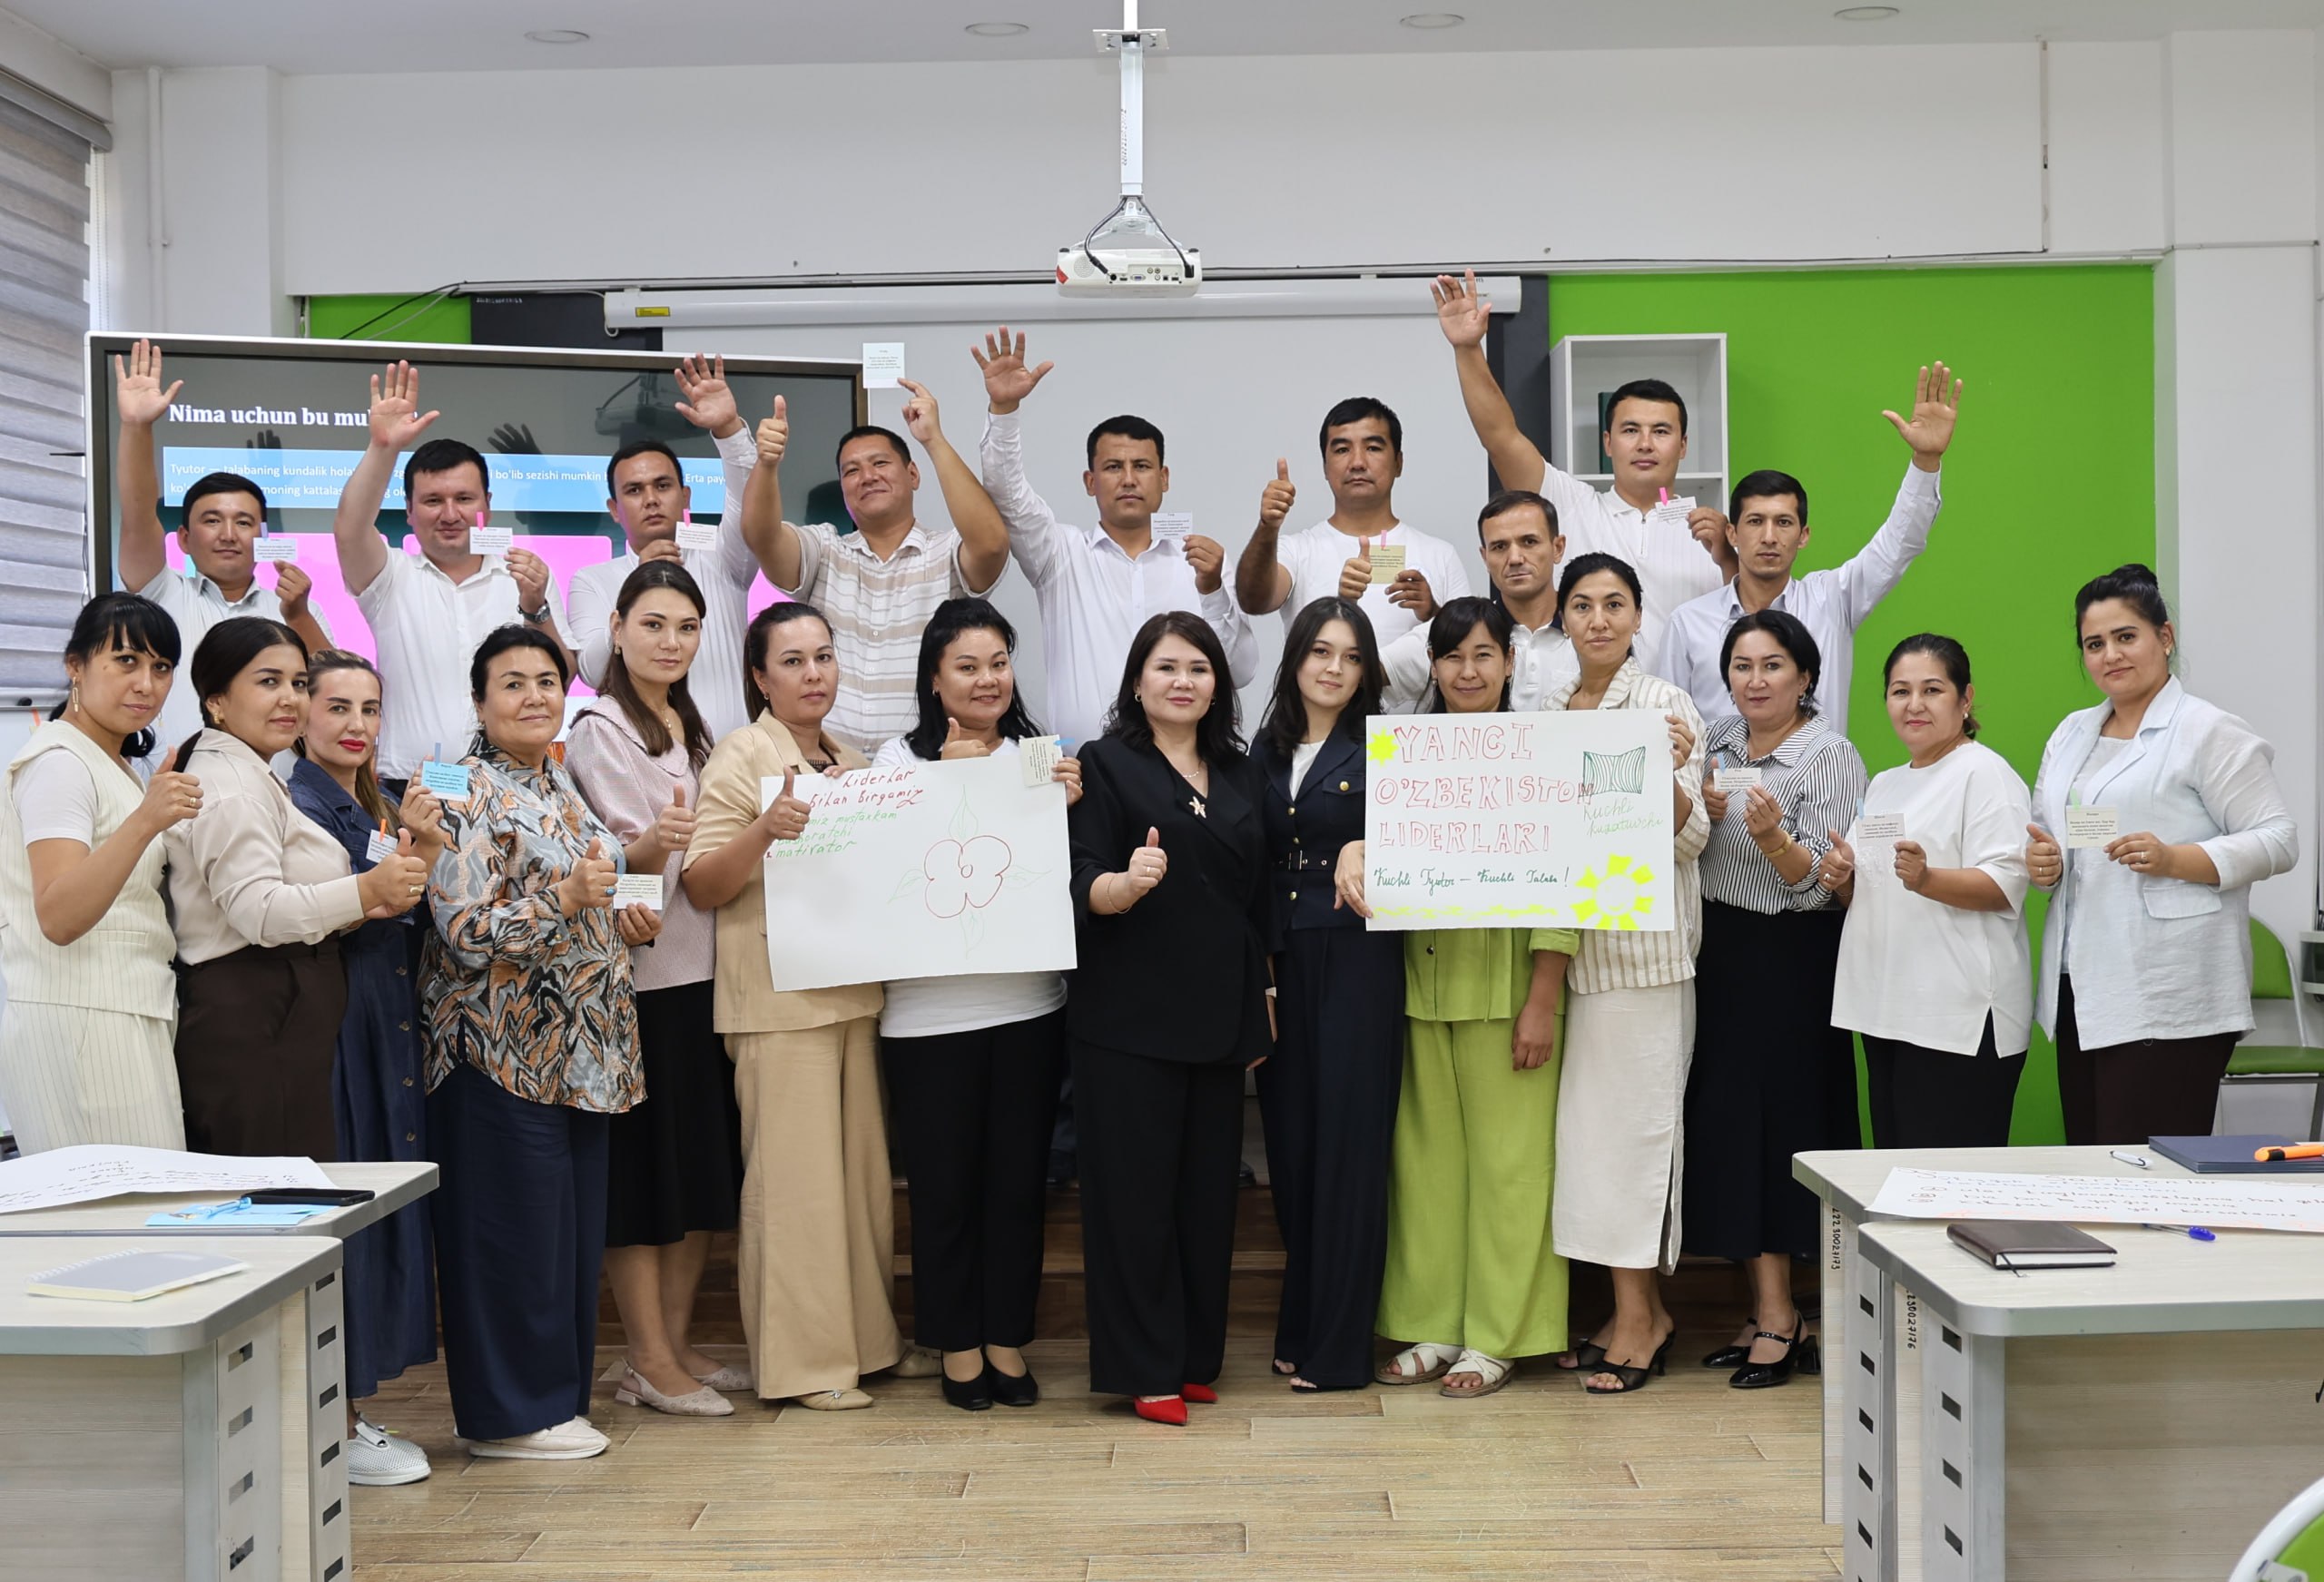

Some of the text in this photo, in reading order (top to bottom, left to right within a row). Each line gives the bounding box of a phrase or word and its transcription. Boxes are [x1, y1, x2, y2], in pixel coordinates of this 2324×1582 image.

[169, 404, 225, 424] Nima
[231, 406, 297, 425] uchun
[301, 408, 330, 425] bu
[170, 464, 205, 476] Tyutor
[223, 465, 281, 477] talabaning
[282, 466, 327, 477] kundalik
[526, 471, 558, 480] sezishi
[561, 472, 602, 481] mumkin
[685, 473, 704, 483] Erta
[261, 485, 344, 497] moning kattalas
[1378, 821, 1550, 854] LIDERLARI
[1374, 867, 1411, 888] Kuchli
[1477, 869, 1515, 883] Kuchli
